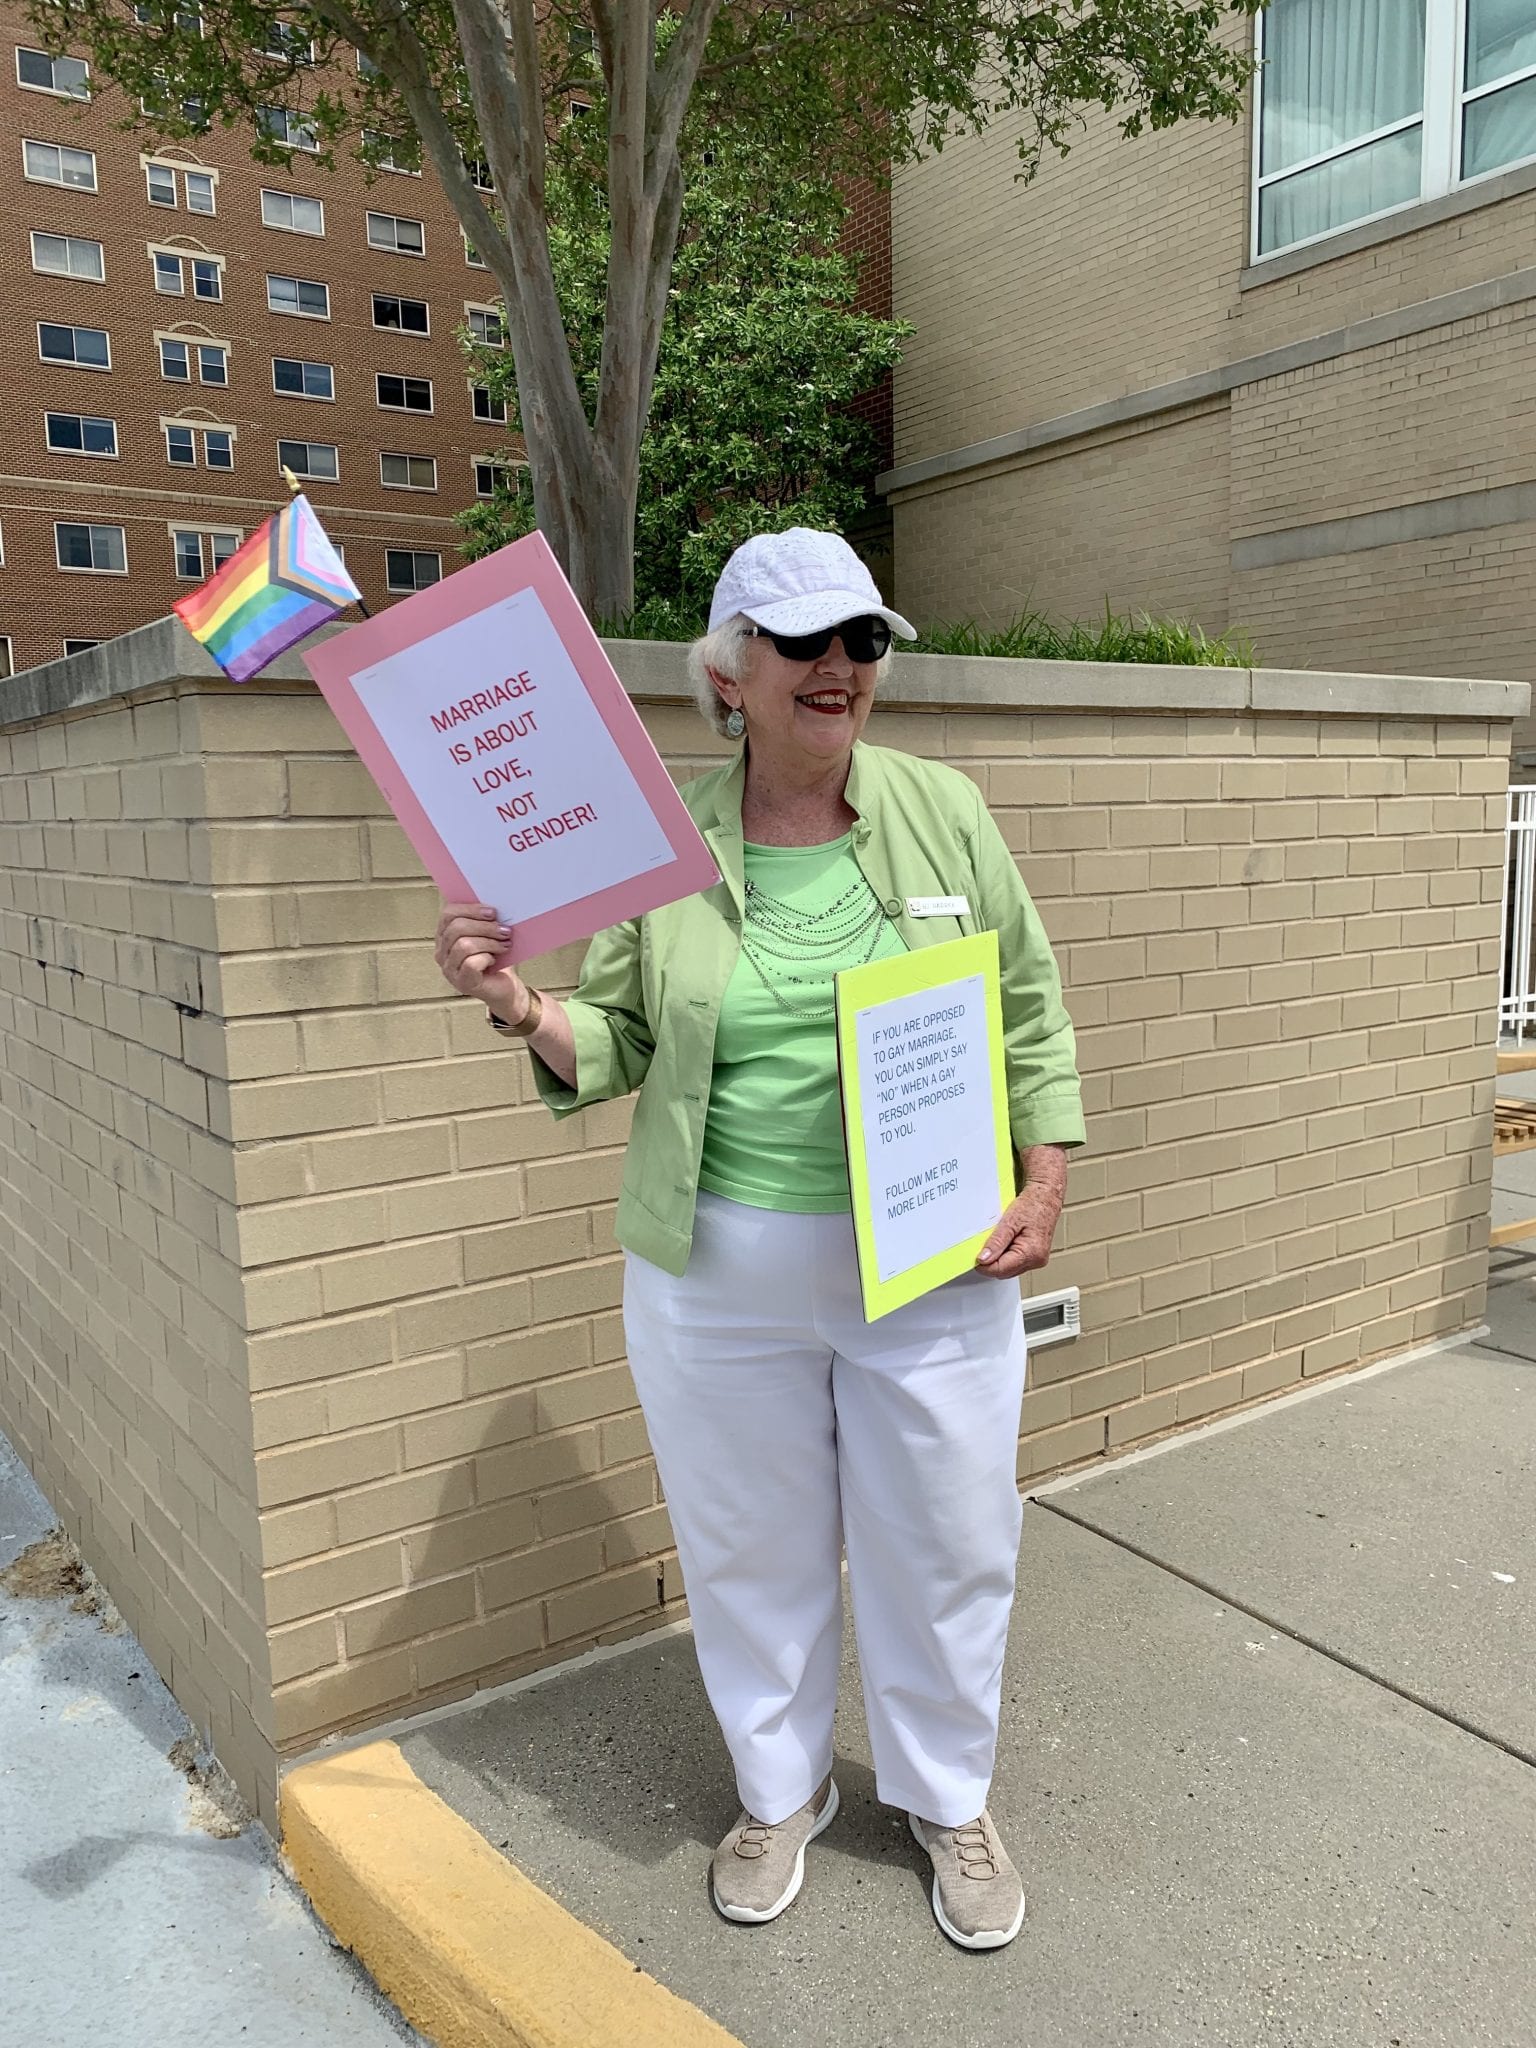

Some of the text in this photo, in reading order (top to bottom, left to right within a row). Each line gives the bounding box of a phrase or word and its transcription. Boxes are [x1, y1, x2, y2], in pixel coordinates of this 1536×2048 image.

[430, 670, 537, 734] MARRIAGE
[449, 711, 538, 765] IS ABOUT
[472, 758, 533, 795] LOVE,
[496, 792, 538, 823] NOT
[508, 803, 598, 853] GENDER!
[873, 1004, 965, 1045] IF YOU ARE OPPOSED
[873, 1027, 957, 1064] TO GAY MARRIAGE,
[875, 1042, 967, 1084] YOU CAN SIMPLY SAY
[901, 1076, 929, 1095] WHEN
[931, 1073, 937, 1084] A
[939, 1066, 955, 1081] GAY
[879, 1083, 965, 1125] PERSON PROPOSES
[880, 1122, 916, 1144] TO YOU.
[886, 1159, 958, 1200] FOLLOW ME FOR
[888, 1178, 958, 1220] MORE LIFE TIPS!
